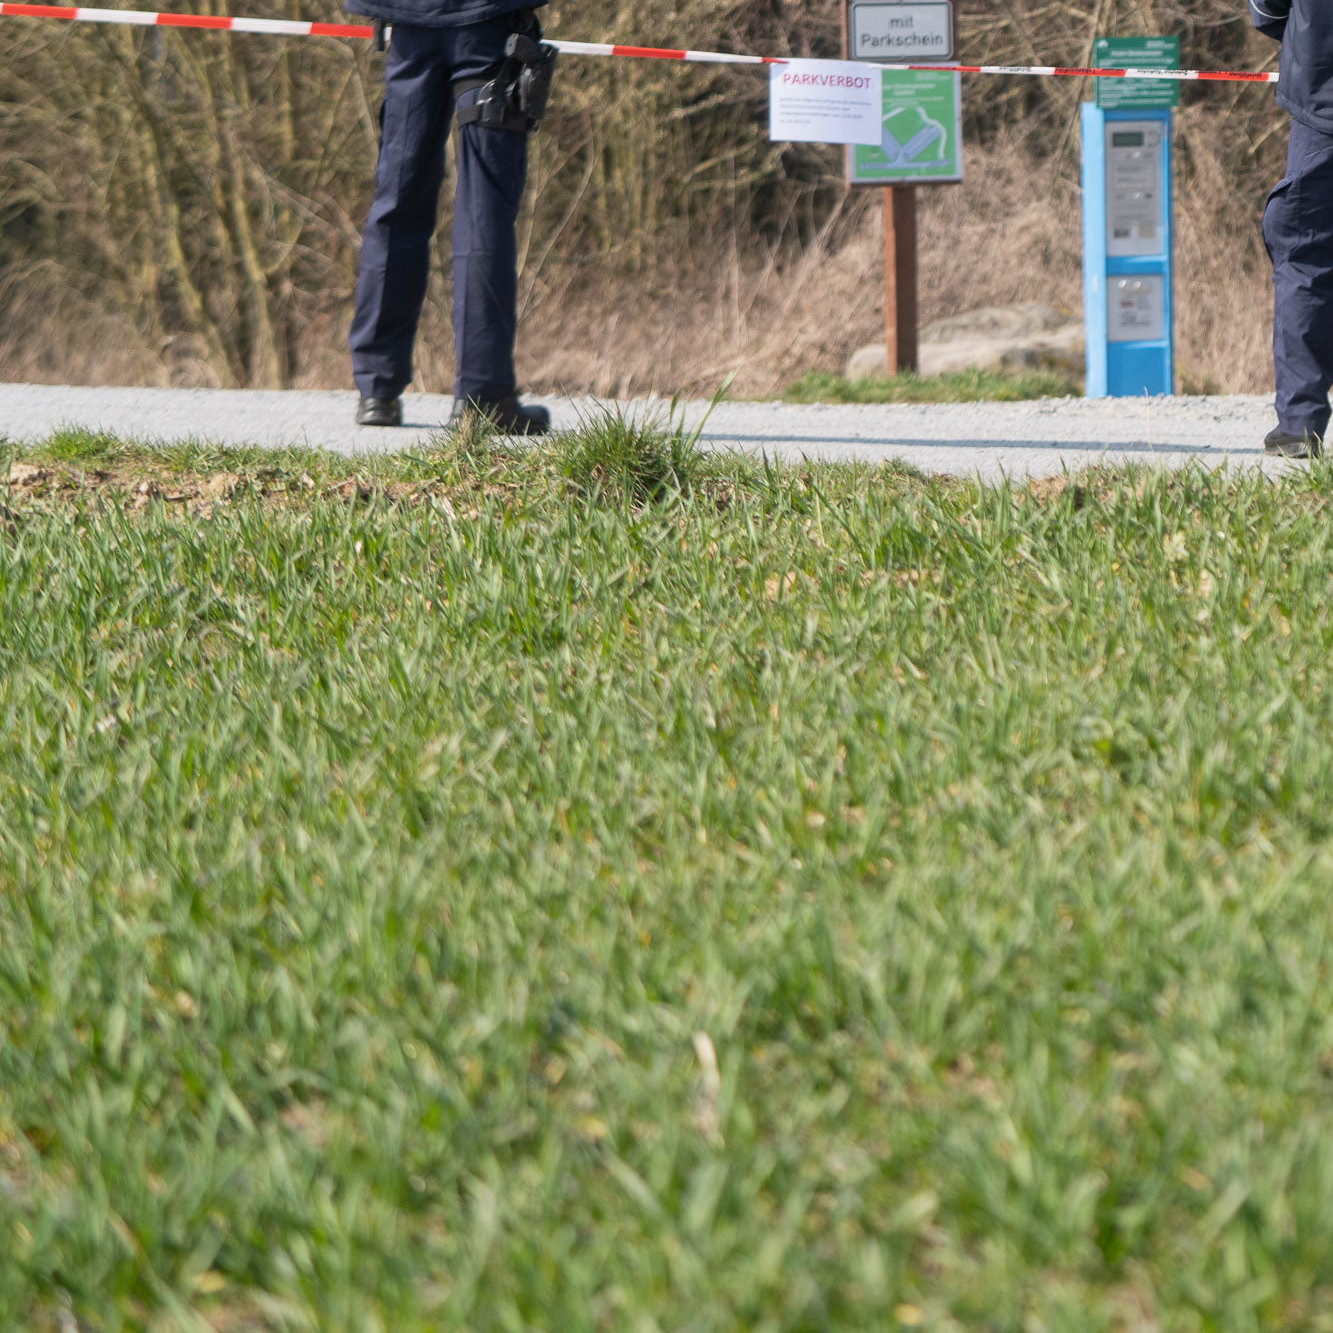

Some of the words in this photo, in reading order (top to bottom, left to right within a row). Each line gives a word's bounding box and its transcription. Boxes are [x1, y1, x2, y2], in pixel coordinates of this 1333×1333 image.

[888, 15, 914, 29] mit
[860, 32, 944, 48] Parkschein
[782, 73, 872, 90] PARKVERBOT
